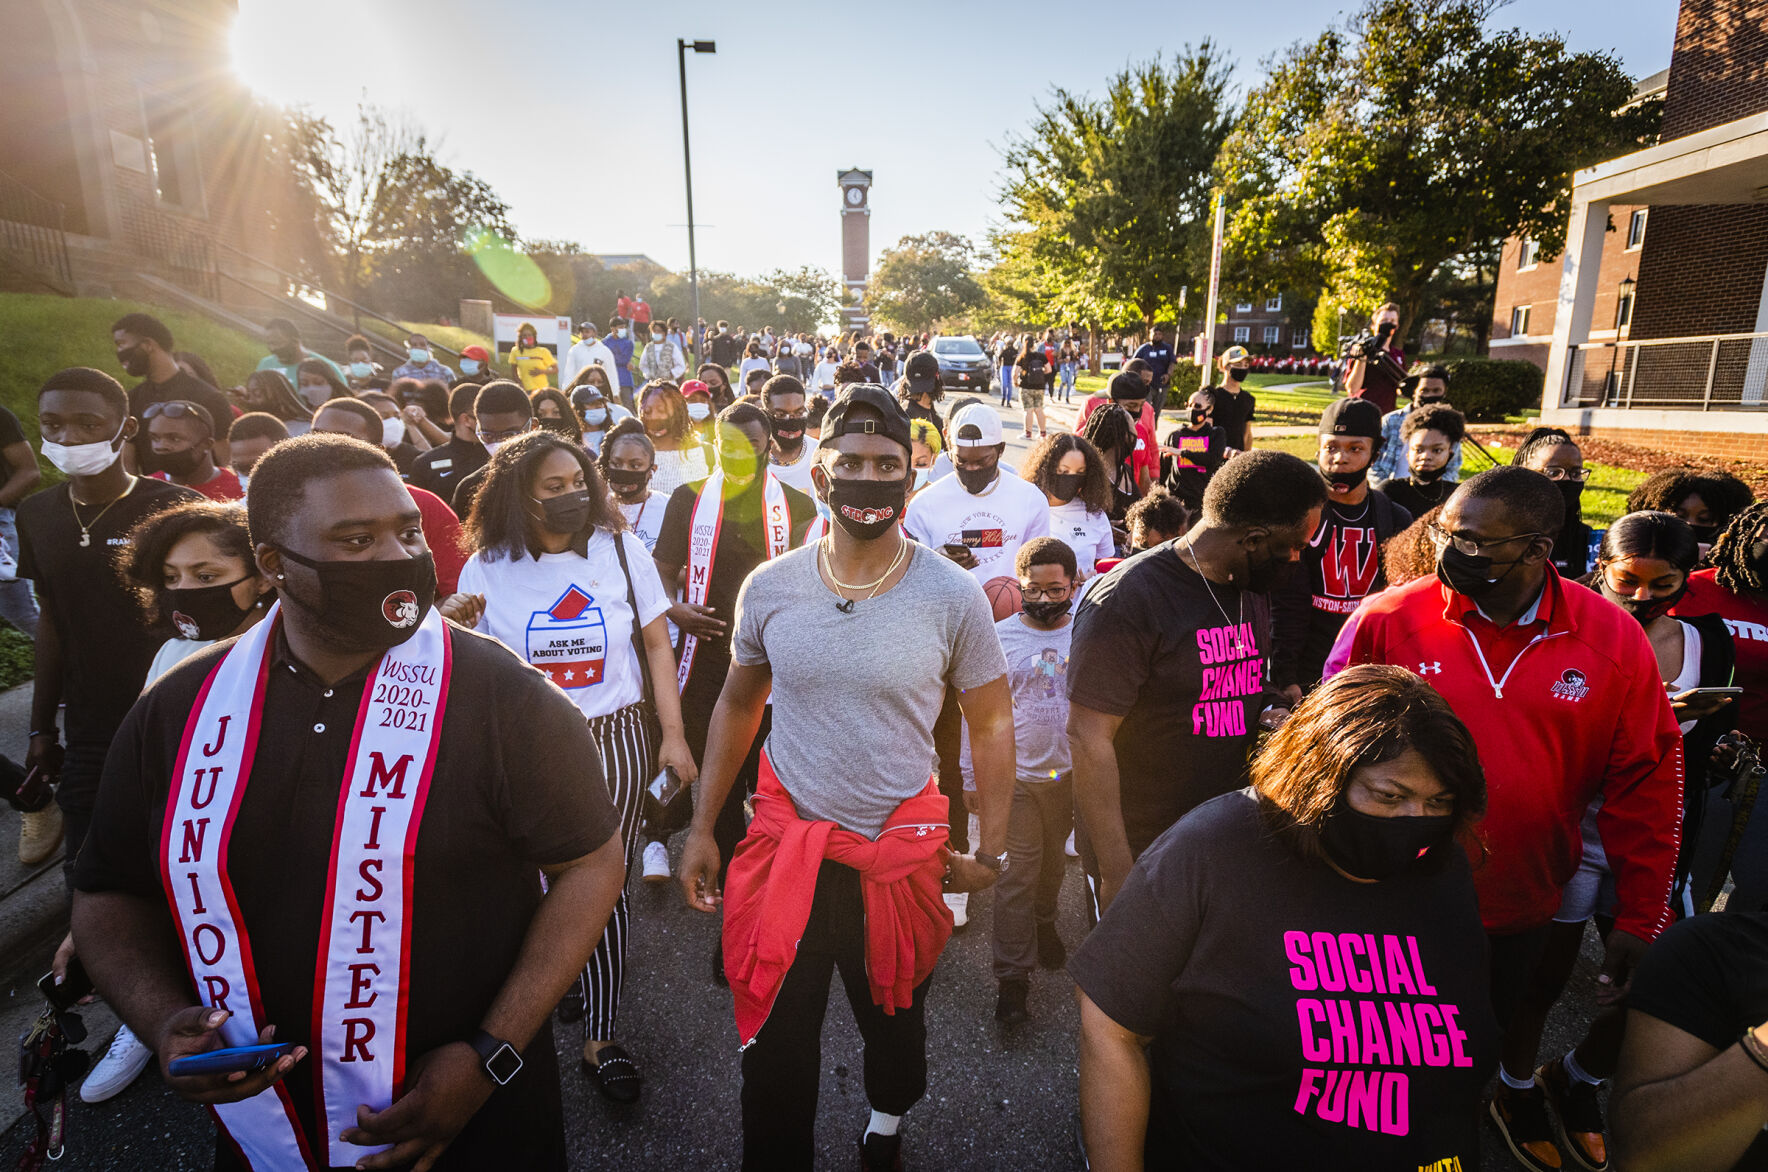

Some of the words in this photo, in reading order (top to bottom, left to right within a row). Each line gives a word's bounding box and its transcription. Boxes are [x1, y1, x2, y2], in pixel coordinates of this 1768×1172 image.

[841, 504, 894, 525] STRONG
[960, 515, 972, 529] NEW
[992, 515, 1006, 527] CITY
[694, 524, 714, 537] WSSU
[944, 531, 981, 547] Tommy
[981, 529, 1017, 546] Hilfiger
[694, 546, 710, 557] 2021
[549, 640, 569, 648] ASK
[571, 638, 585, 647] ME
[1721, 618, 1768, 643] STR
[532, 649, 565, 658] ABOUT
[567, 645, 602, 656] VOTING
[1196, 622, 1259, 665] SOCIAL
[382, 654, 436, 686] WSSU
[1199, 658, 1263, 701] CHANGE
[373, 683, 431, 708] 2020-
[379, 707, 428, 732] 2021
[1192, 700, 1247, 738] FUND
[178, 715, 234, 1017] JUNIOR
[339, 751, 414, 1063] MISTER
[1283, 930, 1438, 996] SOCIAL
[1296, 998, 1473, 1068] CHANGE
[1294, 1067, 1409, 1136] FUND
